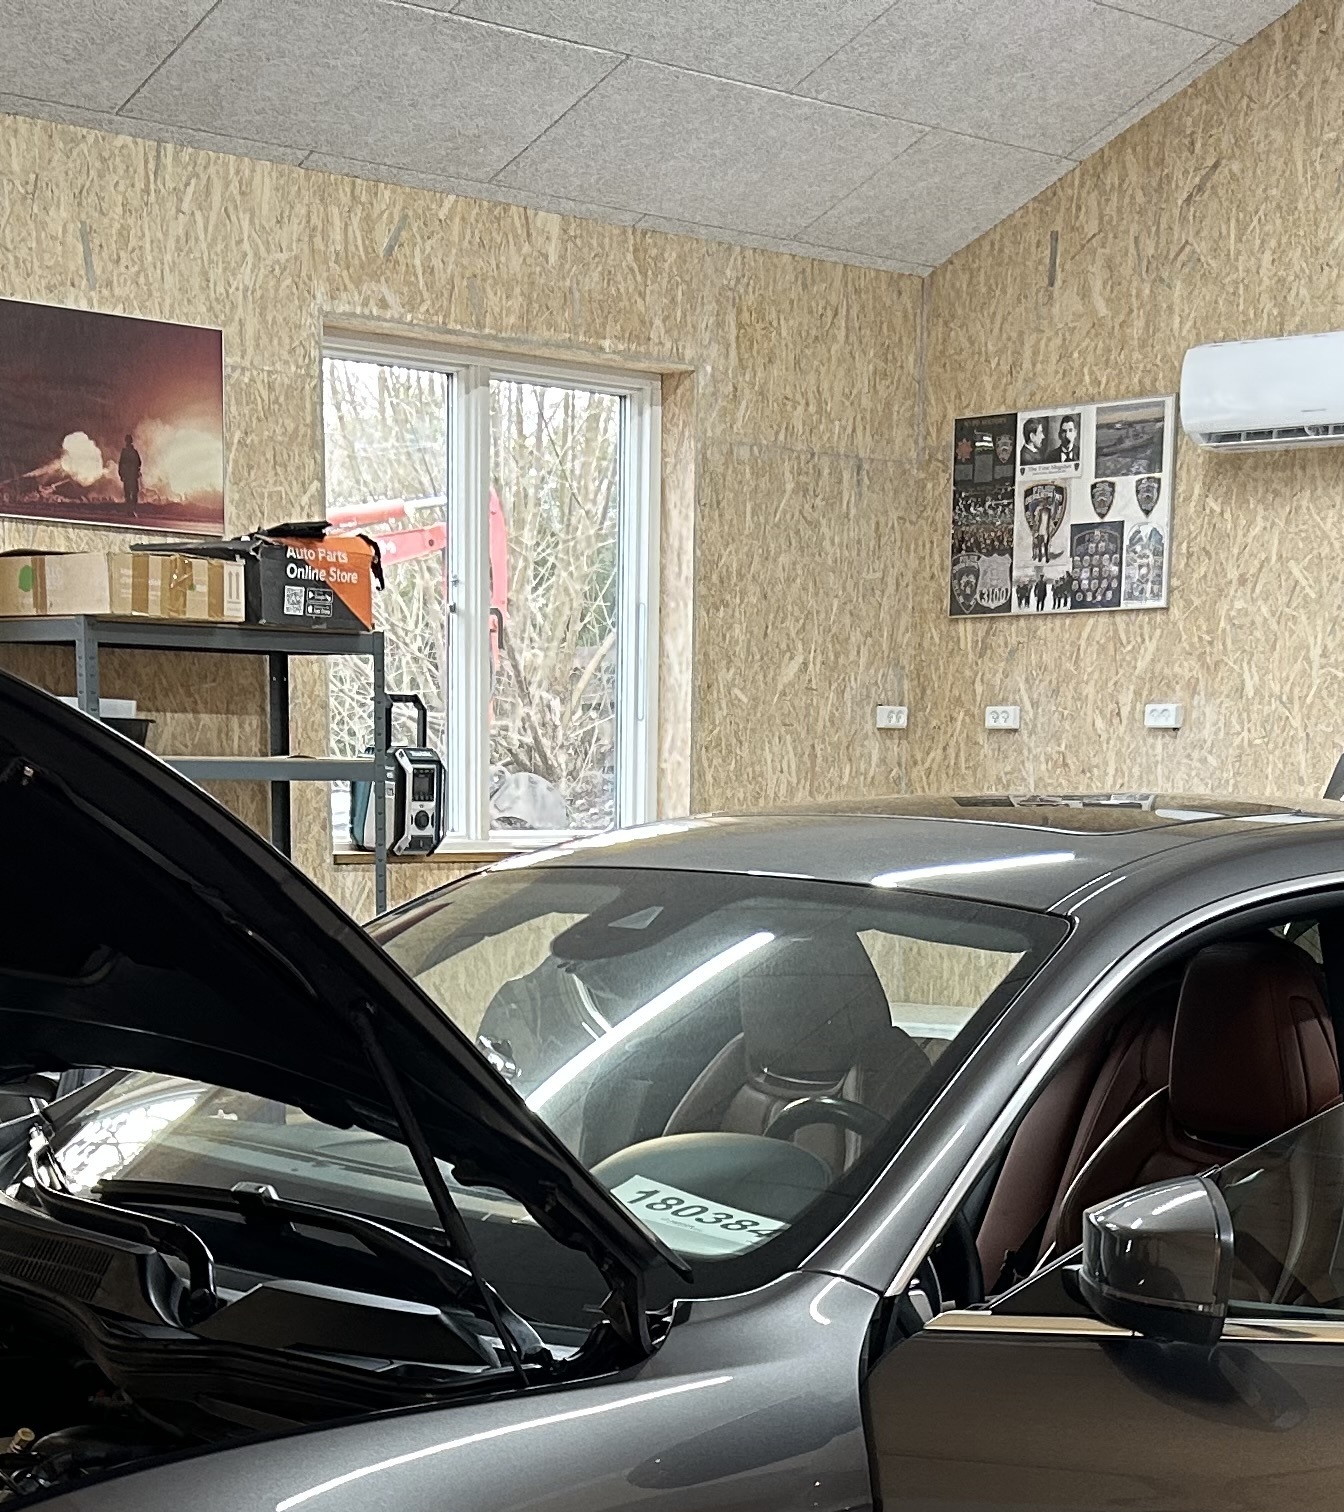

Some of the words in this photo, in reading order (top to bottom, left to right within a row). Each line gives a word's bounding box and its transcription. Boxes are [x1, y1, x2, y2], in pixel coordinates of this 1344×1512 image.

[286, 546, 315, 560] Auto
[318, 548, 348, 563] Parts
[286, 563, 326, 581] Online
[329, 567, 358, 584] Store
